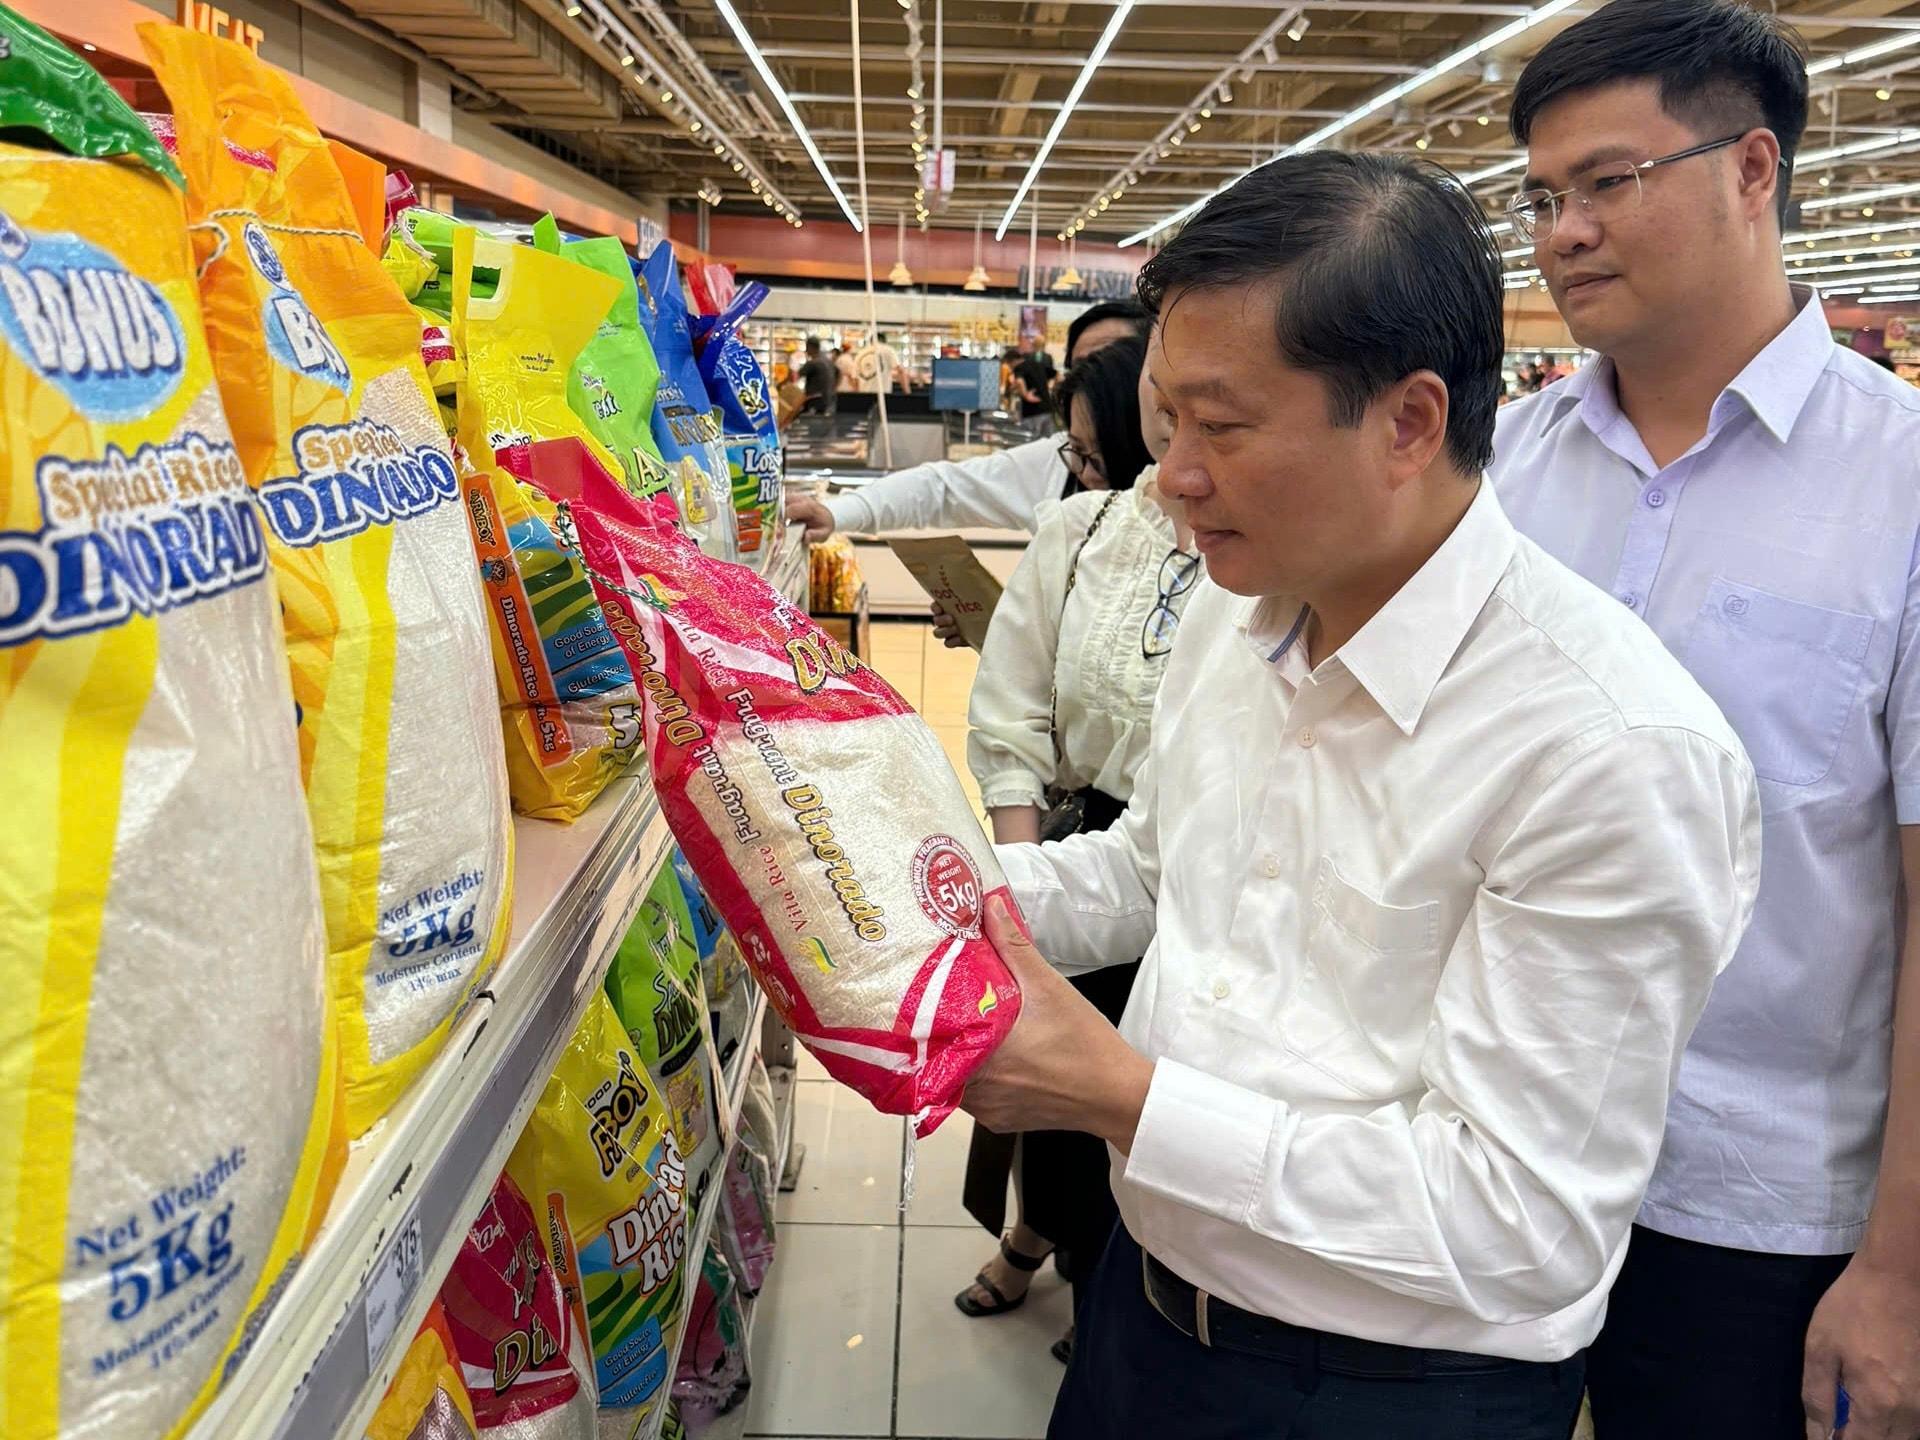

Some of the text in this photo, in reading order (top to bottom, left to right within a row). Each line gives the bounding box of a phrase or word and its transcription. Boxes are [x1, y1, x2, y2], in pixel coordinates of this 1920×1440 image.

[0, 263, 182, 382] BONUS
[166, 444, 244, 500] Rice
[0, 498, 267, 636] DINORAD
[500, 594, 529, 666] Dinorado
[521, 664, 540, 699] Rice
[554, 630, 584, 650] Good
[692, 742, 761, 846] Fragrant
[725, 686, 799, 787] Fragrant
[781, 782, 887, 942] Dinorado
[759, 845, 788, 889] Rice
[937, 865, 962, 882] WEIGHT
[938, 856, 952, 869] NET
[786, 888, 809, 934] Vita
[938, 880, 978, 916] 5kg
[374, 942, 483, 988] Moisture Content
[435, 966, 463, 984] max
[75, 1146, 247, 1268] Net Weight:
[108, 1200, 236, 1322] 5Kg
[639, 1223, 686, 1295] Ric
